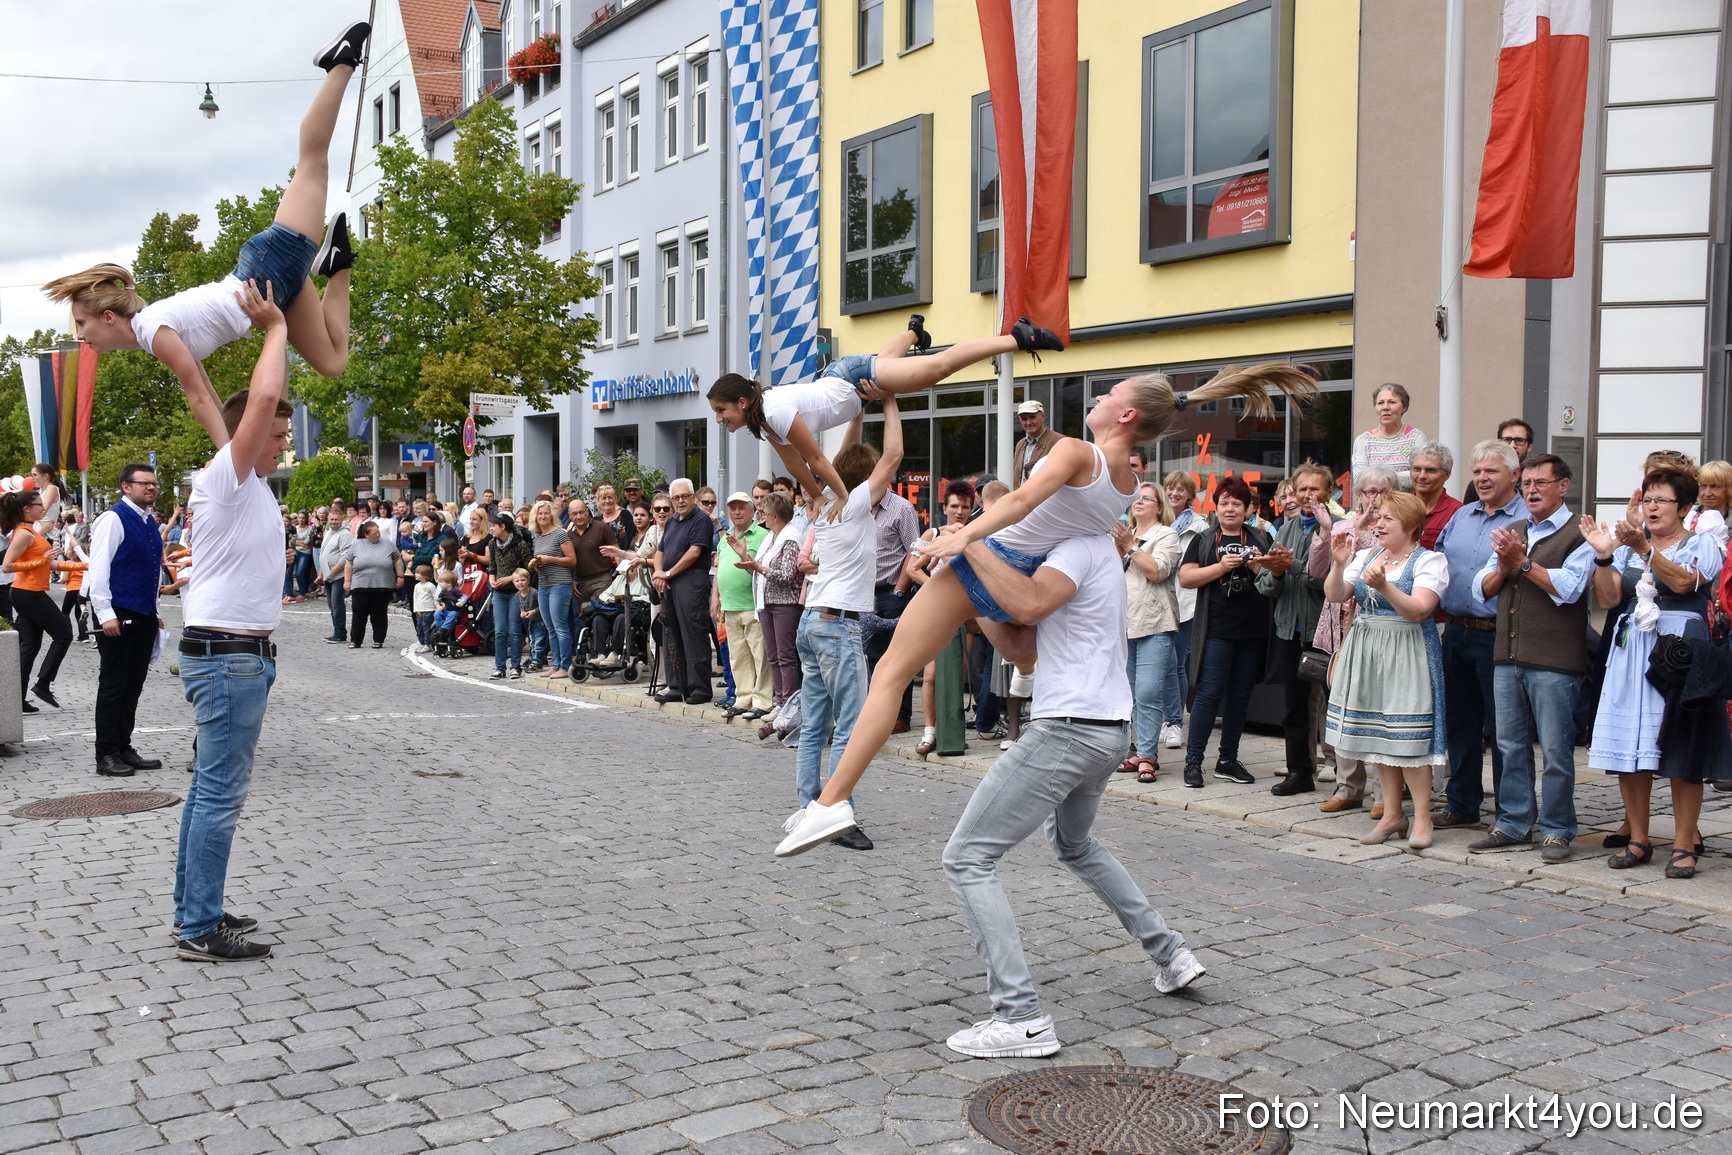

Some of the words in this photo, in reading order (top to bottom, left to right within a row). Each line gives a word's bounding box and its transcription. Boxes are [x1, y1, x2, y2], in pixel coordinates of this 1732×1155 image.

[1216, 205, 1226, 213] Tel.
[611, 367, 694, 401] Raiffeisenbank
[475, 394, 519, 404] Brunnwirtsgasse
[1217, 545, 1237, 553] Hard
